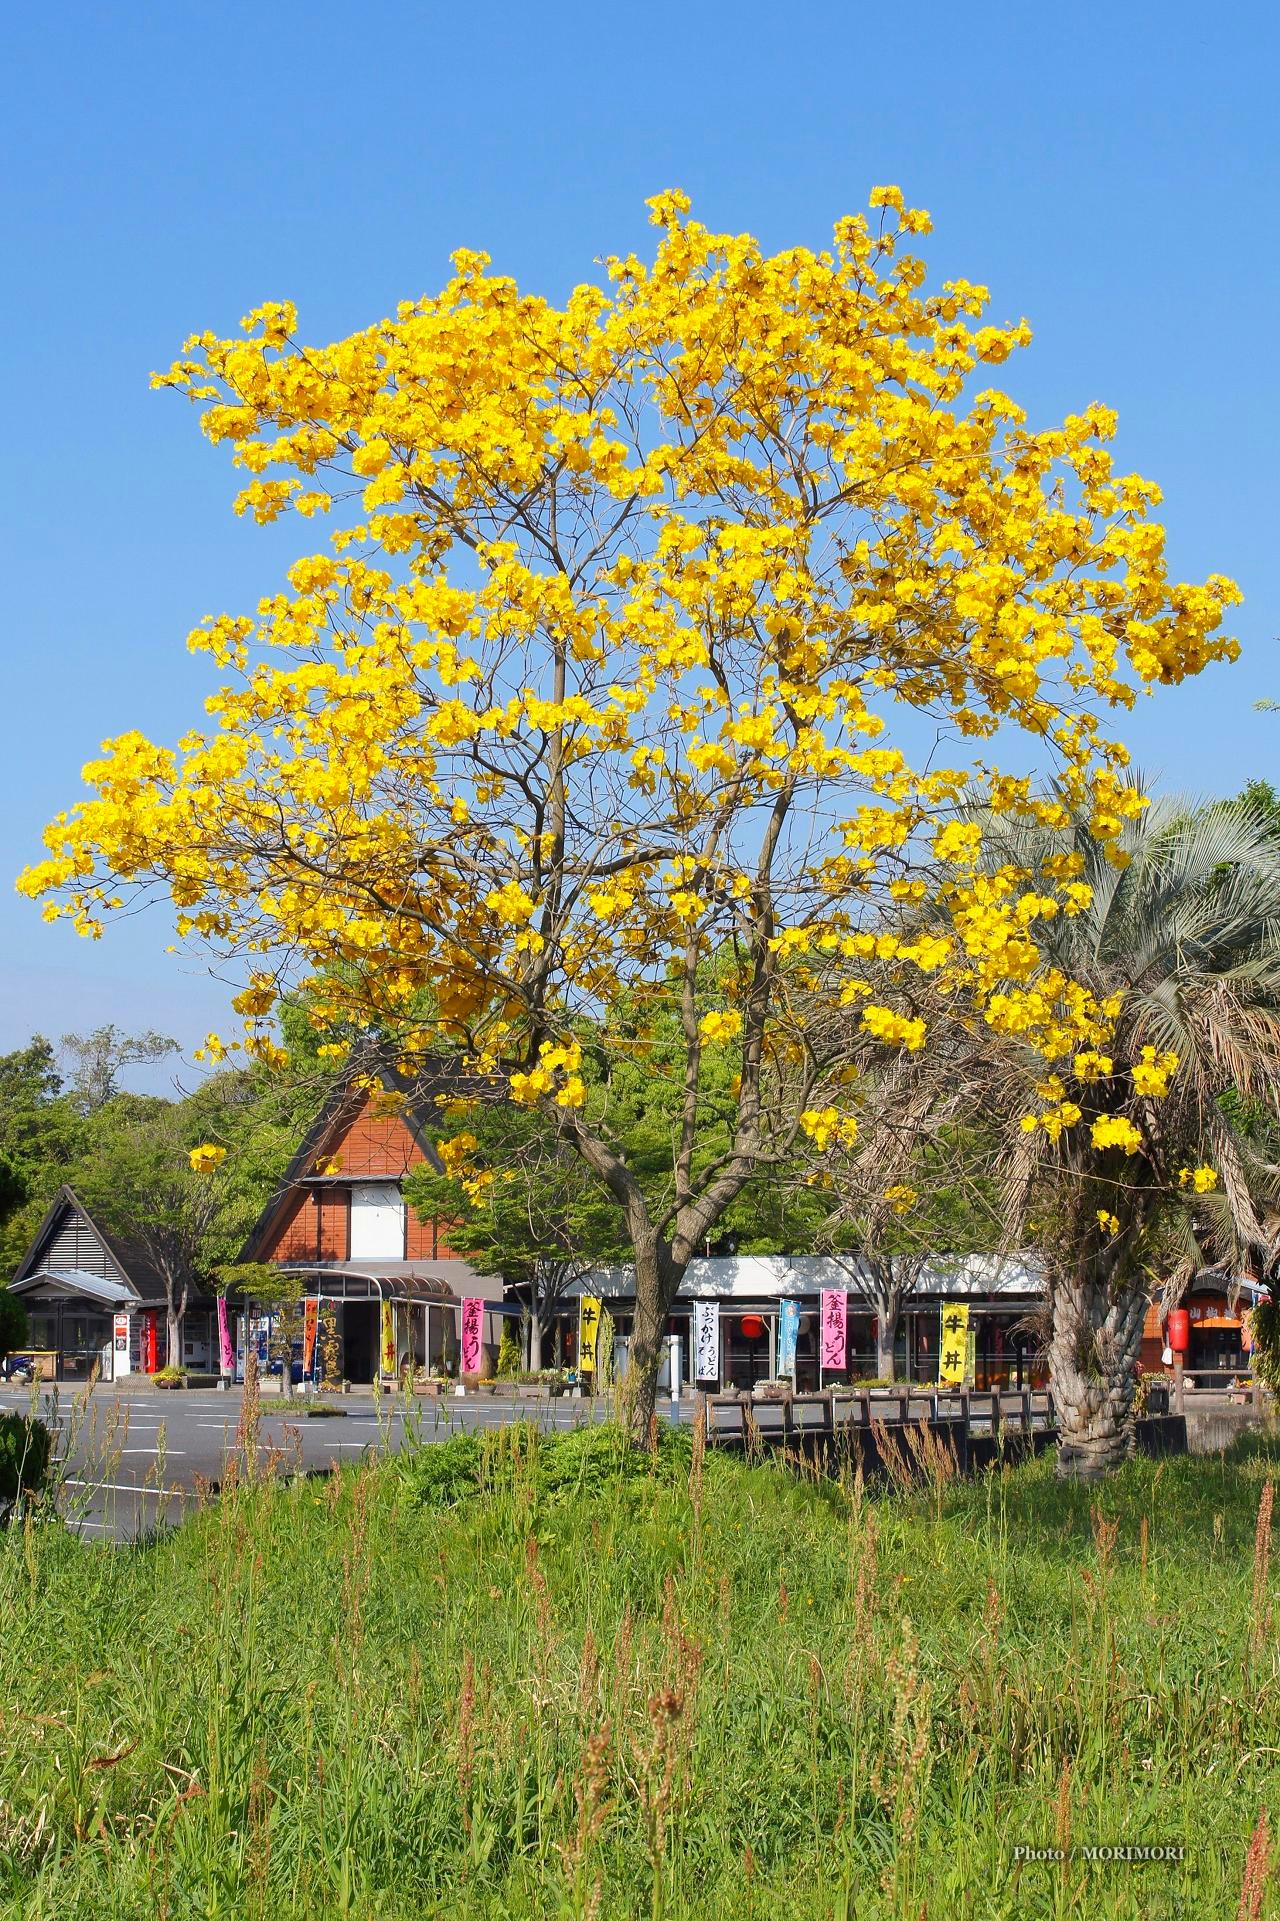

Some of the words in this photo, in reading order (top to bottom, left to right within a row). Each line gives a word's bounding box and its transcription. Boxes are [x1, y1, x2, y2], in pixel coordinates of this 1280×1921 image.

[463, 1302, 481, 1370] 釜揚うどん
[580, 1307, 597, 1361] 牛丼
[825, 1294, 845, 1366] 釜揚うどん
[942, 1314, 964, 1372] 牛丼
